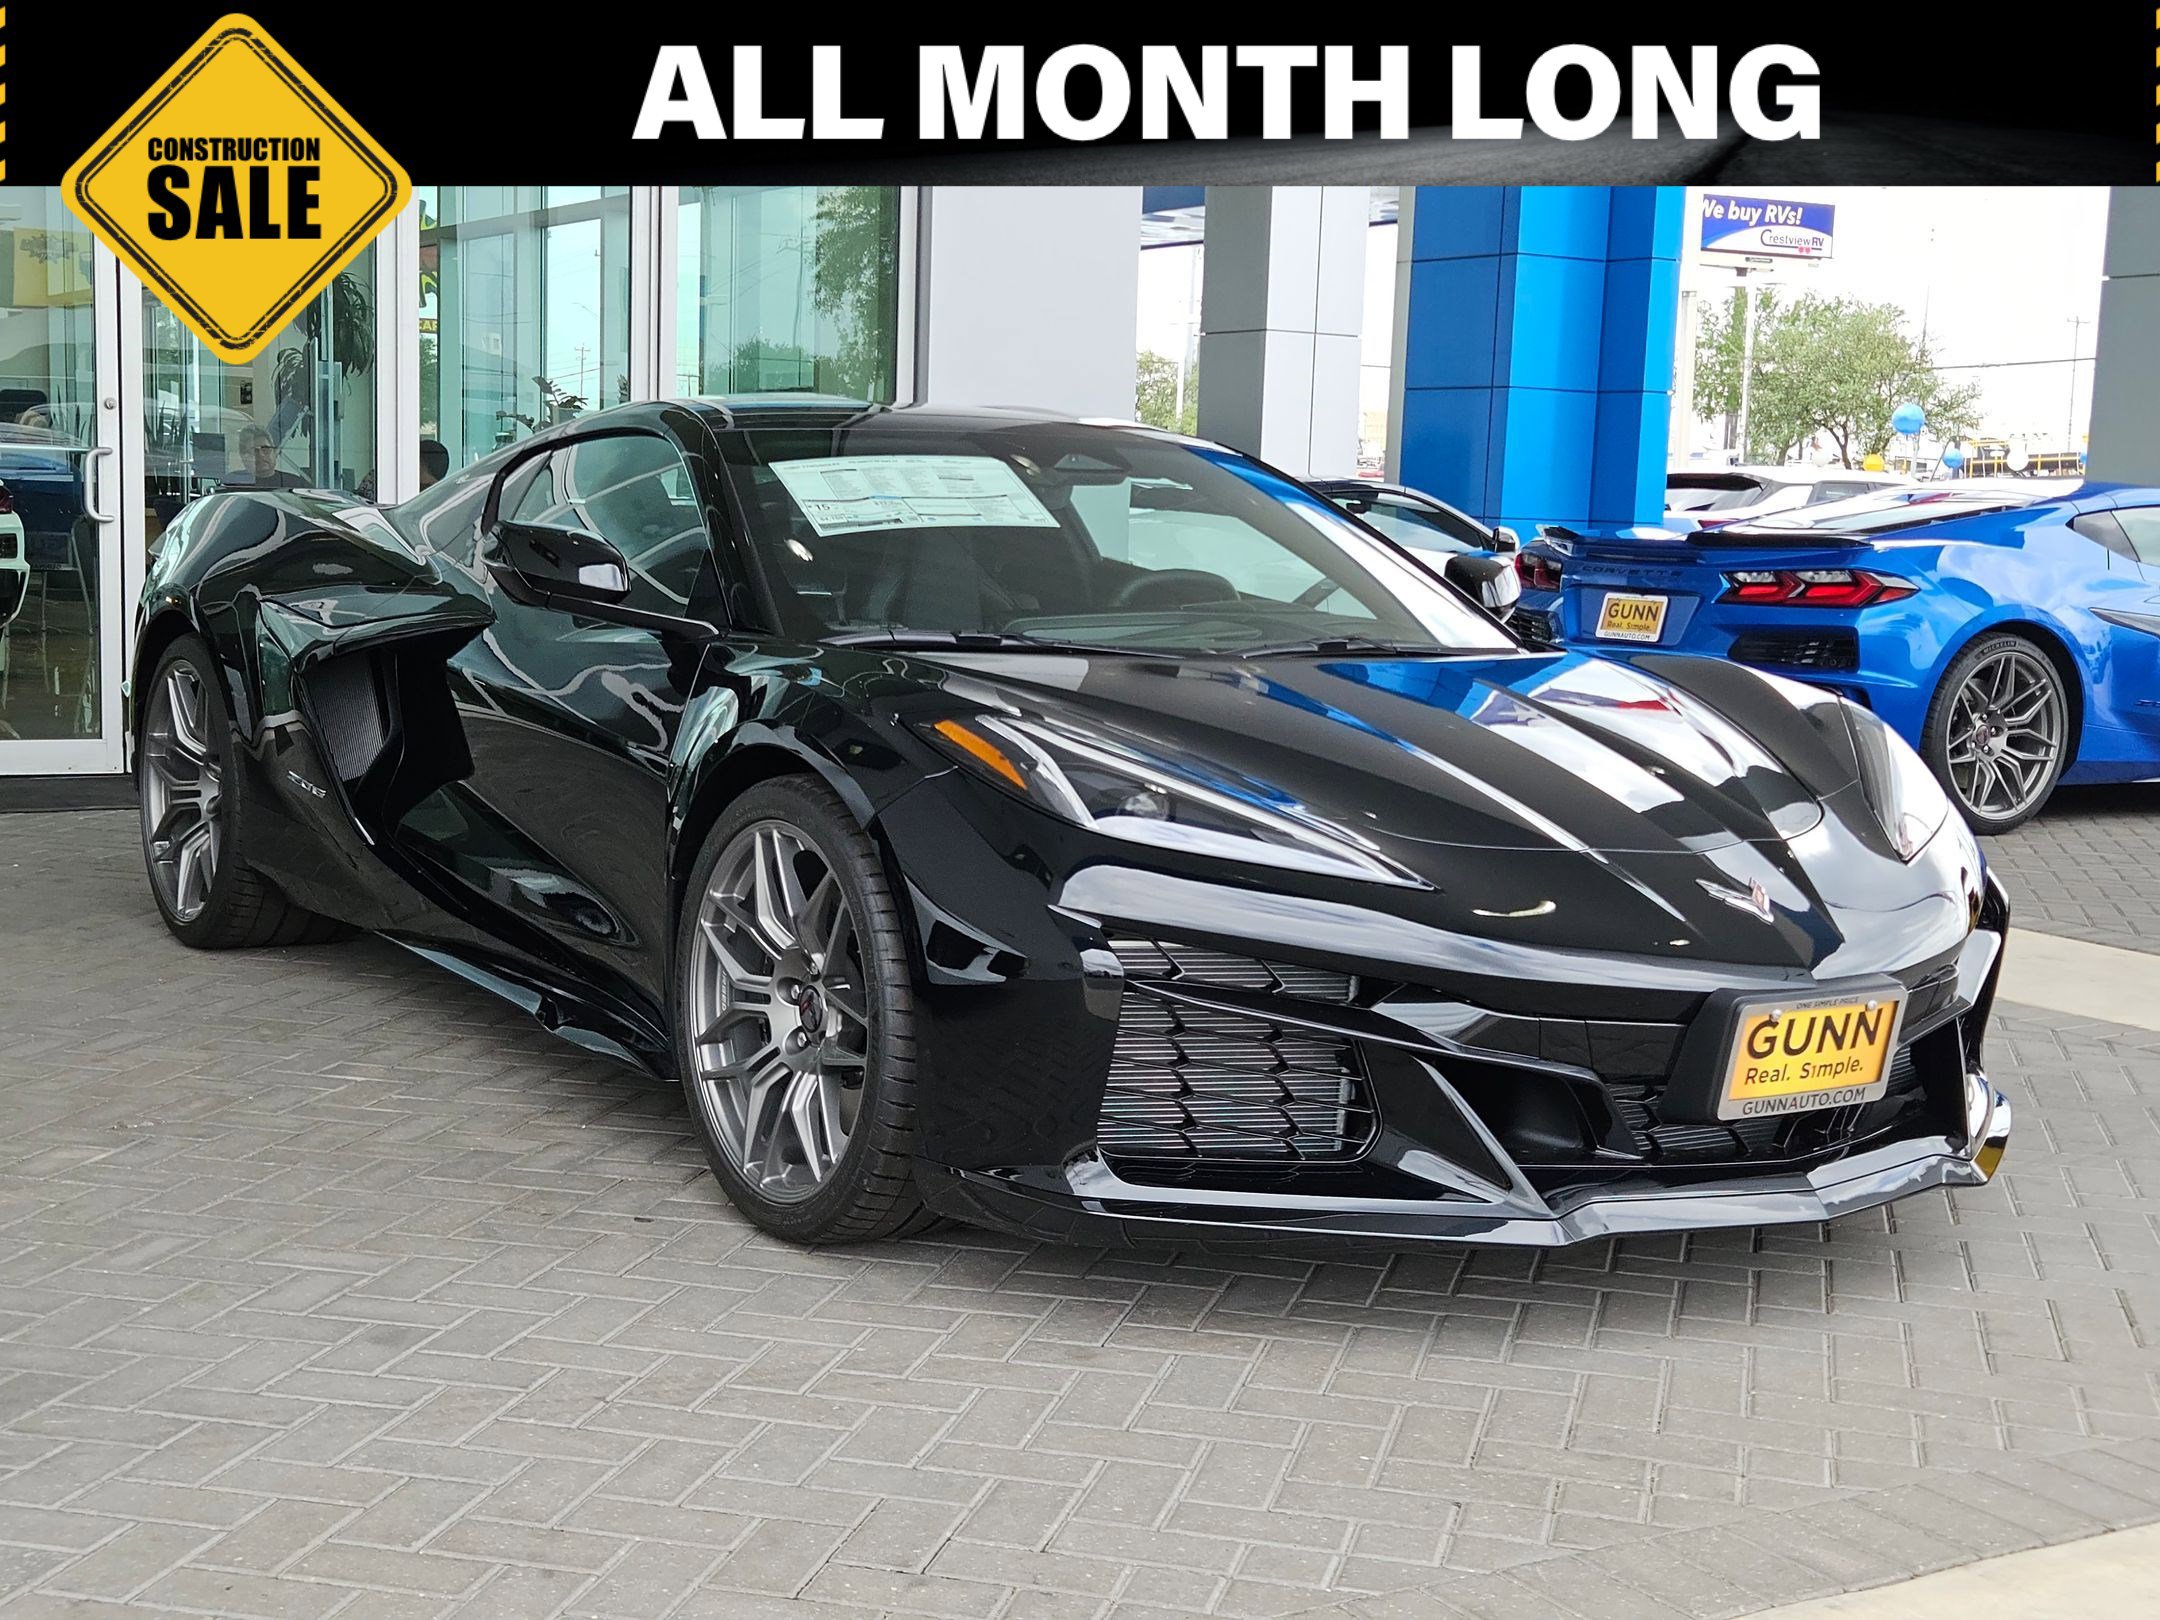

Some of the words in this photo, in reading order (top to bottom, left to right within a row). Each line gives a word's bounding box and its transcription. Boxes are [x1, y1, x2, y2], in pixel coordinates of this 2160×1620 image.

[1728, 200, 1762, 226] buy
[1764, 203, 1803, 225] RVs!
[1760, 228, 1811, 246] Crestview
[1582, 565, 1682, 577] CORVETTE
[1608, 602, 1660, 622] GUNN
[1603, 631, 1651, 640] GUNNAUTO.COM
[1607, 620, 1624, 630] Real.
[1626, 622, 1652, 632] Simple.
[1746, 1008, 1883, 1060] GUNN
[1744, 1063, 1791, 1086] Real.
[1799, 1055, 1864, 1082] Simple.
[1742, 1087, 1867, 1116] GUNNAUTO.COM
